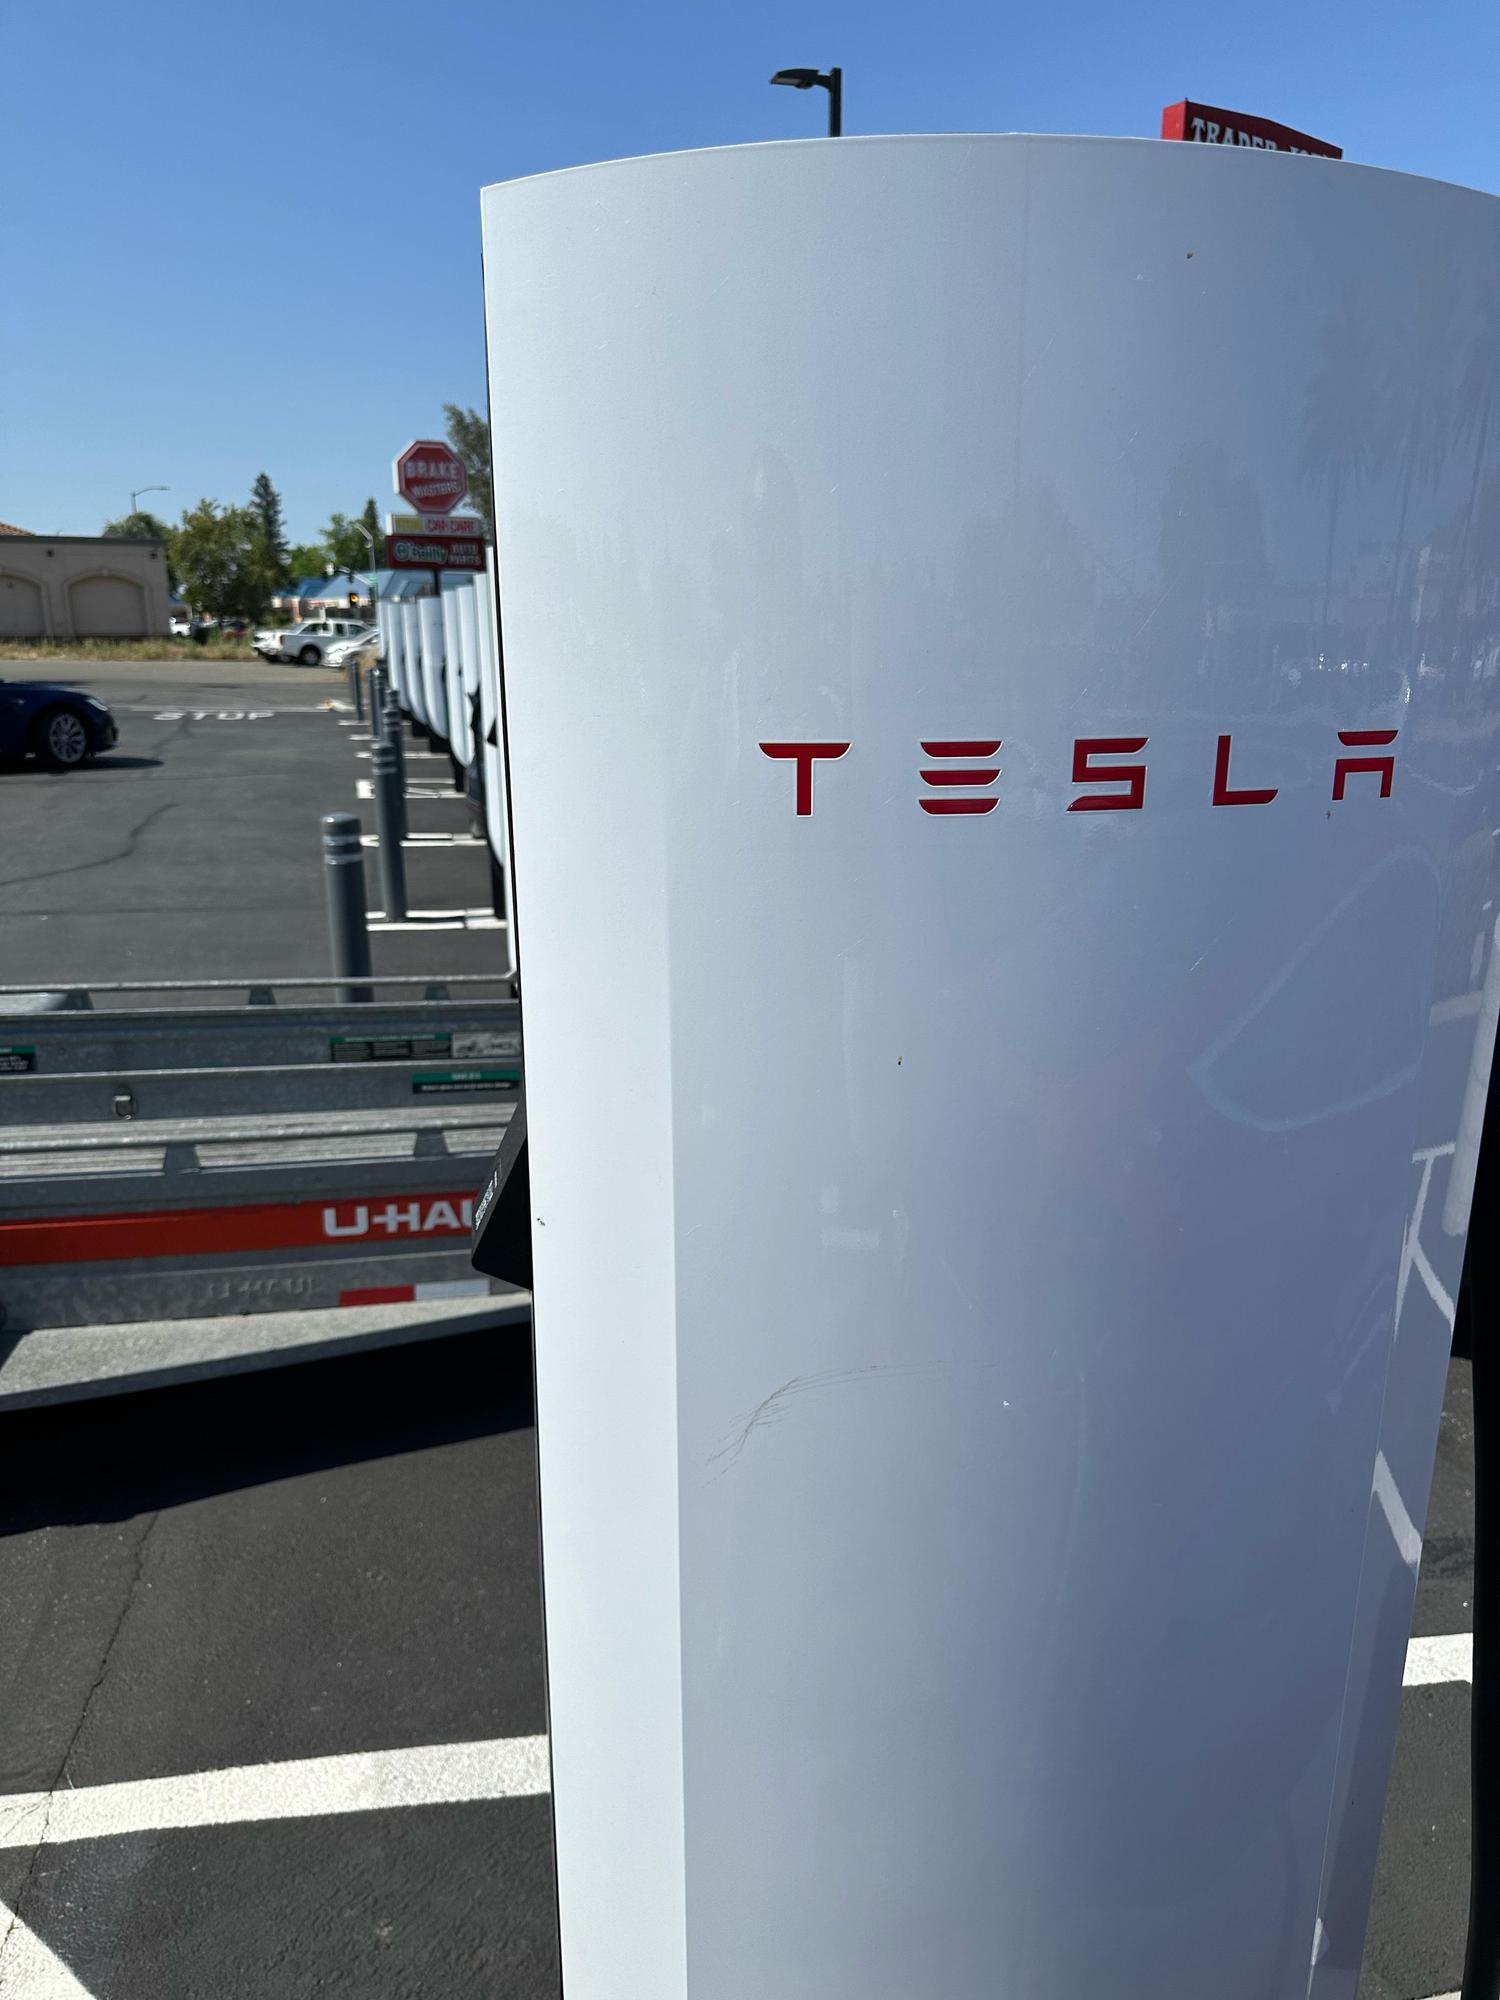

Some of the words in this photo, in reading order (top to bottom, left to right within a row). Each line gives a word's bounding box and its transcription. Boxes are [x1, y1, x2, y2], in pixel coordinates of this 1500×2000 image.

[405, 462, 458, 479] BRAKE
[152, 711, 276, 721] STOP
[758, 729, 1400, 818] TESLA
[323, 1200, 473, 1237] U-HA
